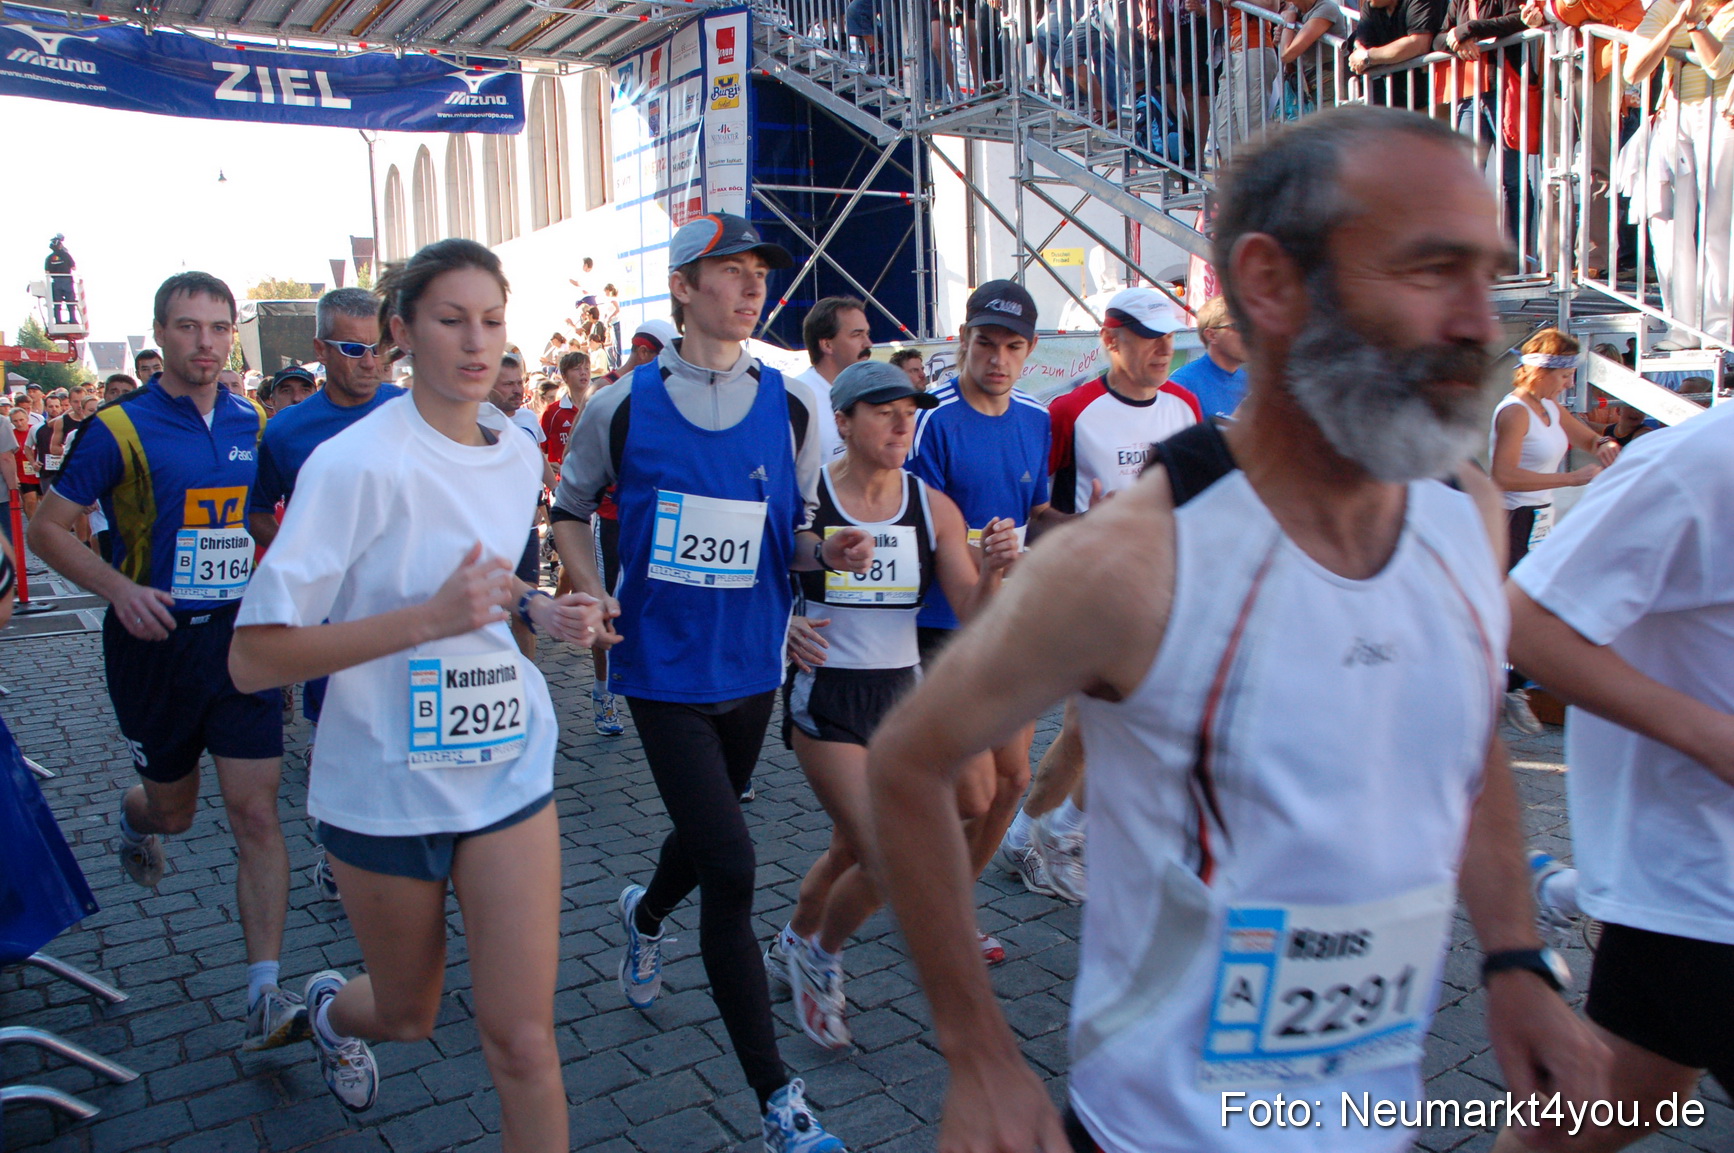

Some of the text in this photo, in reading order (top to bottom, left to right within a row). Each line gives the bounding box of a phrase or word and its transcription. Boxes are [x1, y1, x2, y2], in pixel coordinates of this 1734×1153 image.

[211, 61, 352, 109] ZIEL
[1042, 366, 1064, 377] zum
[200, 536, 249, 550] Christian
[680, 534, 750, 564] 2301
[180, 556, 249, 581] B 3164
[446, 664, 517, 688] Katharina
[419, 698, 520, 736] B 2922
[1224, 963, 1417, 1037] A 2291
